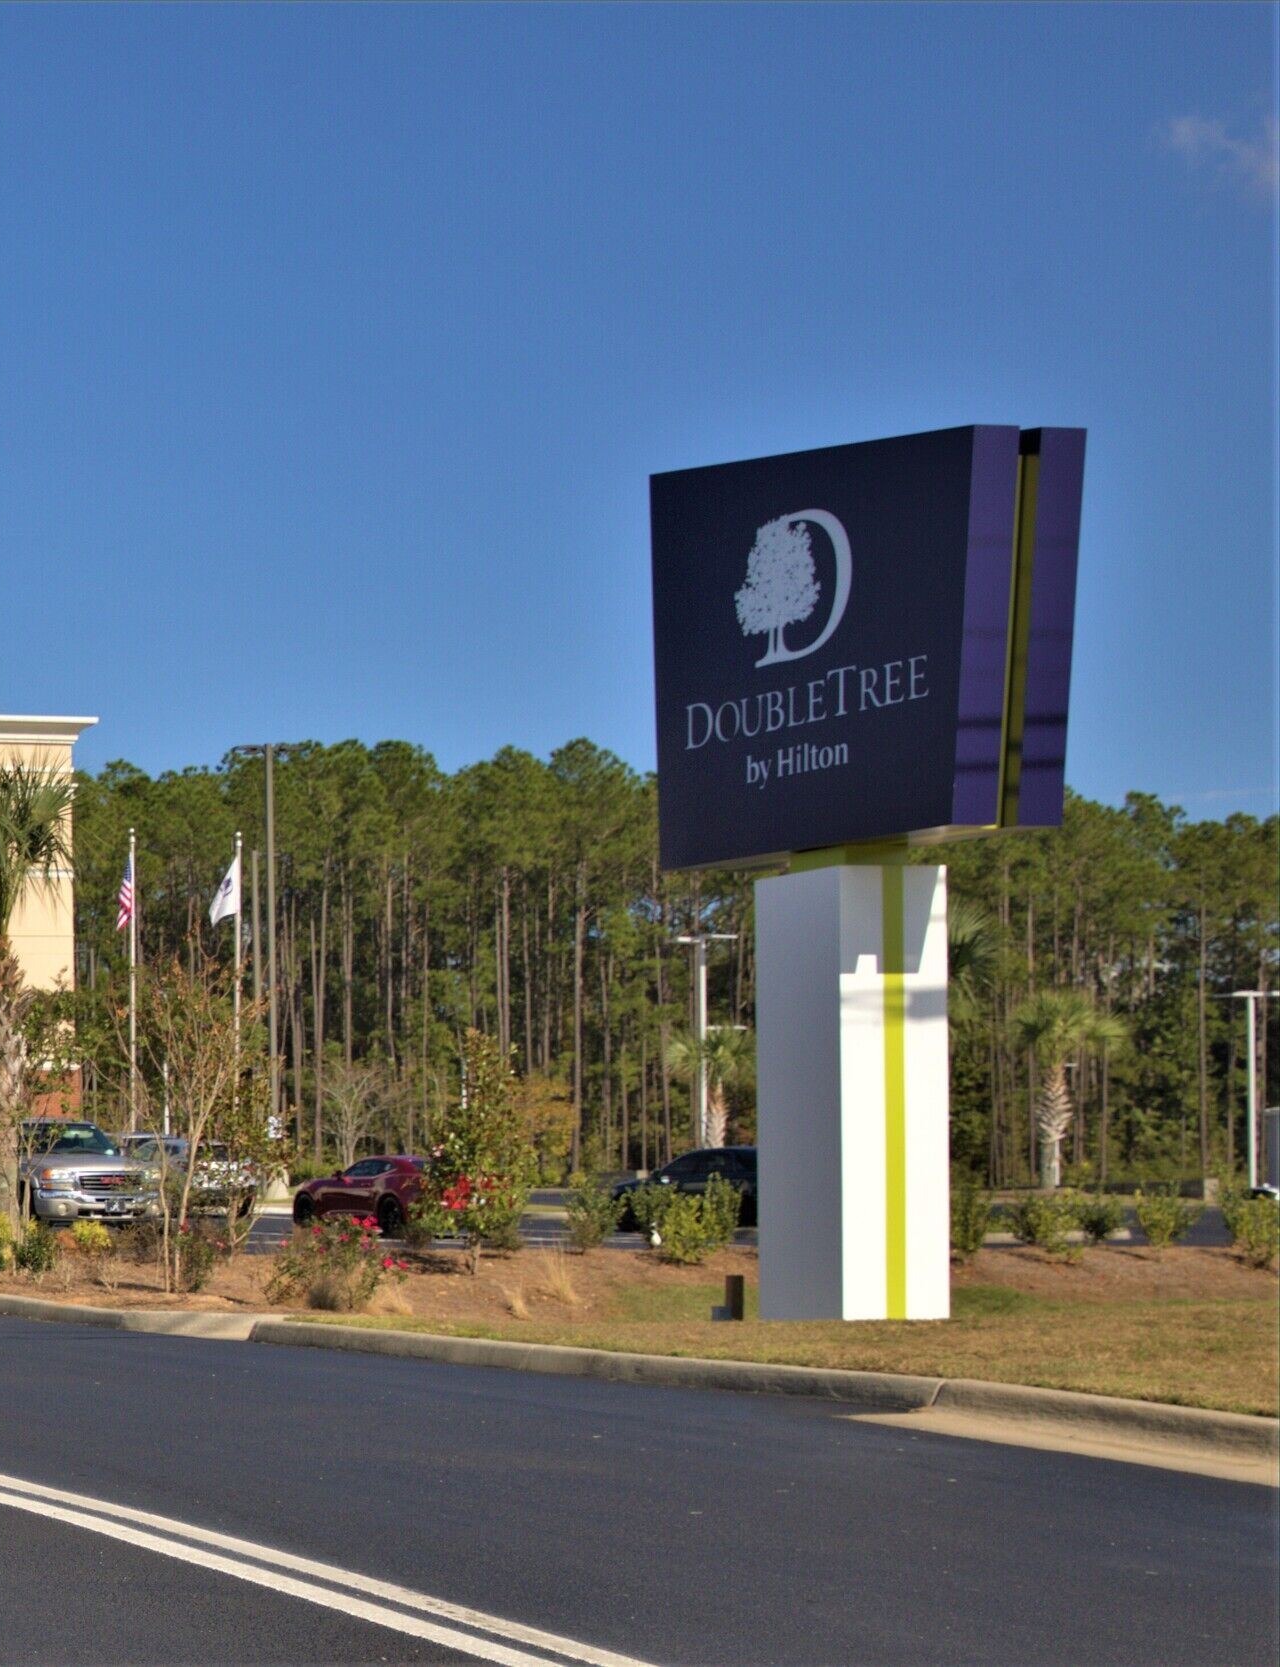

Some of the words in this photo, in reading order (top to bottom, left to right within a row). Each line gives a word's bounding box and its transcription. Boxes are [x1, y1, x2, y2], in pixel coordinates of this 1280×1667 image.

[684, 655, 930, 750] DOUBLETREE
[746, 756, 774, 789] by
[777, 742, 849, 778] Hilton
